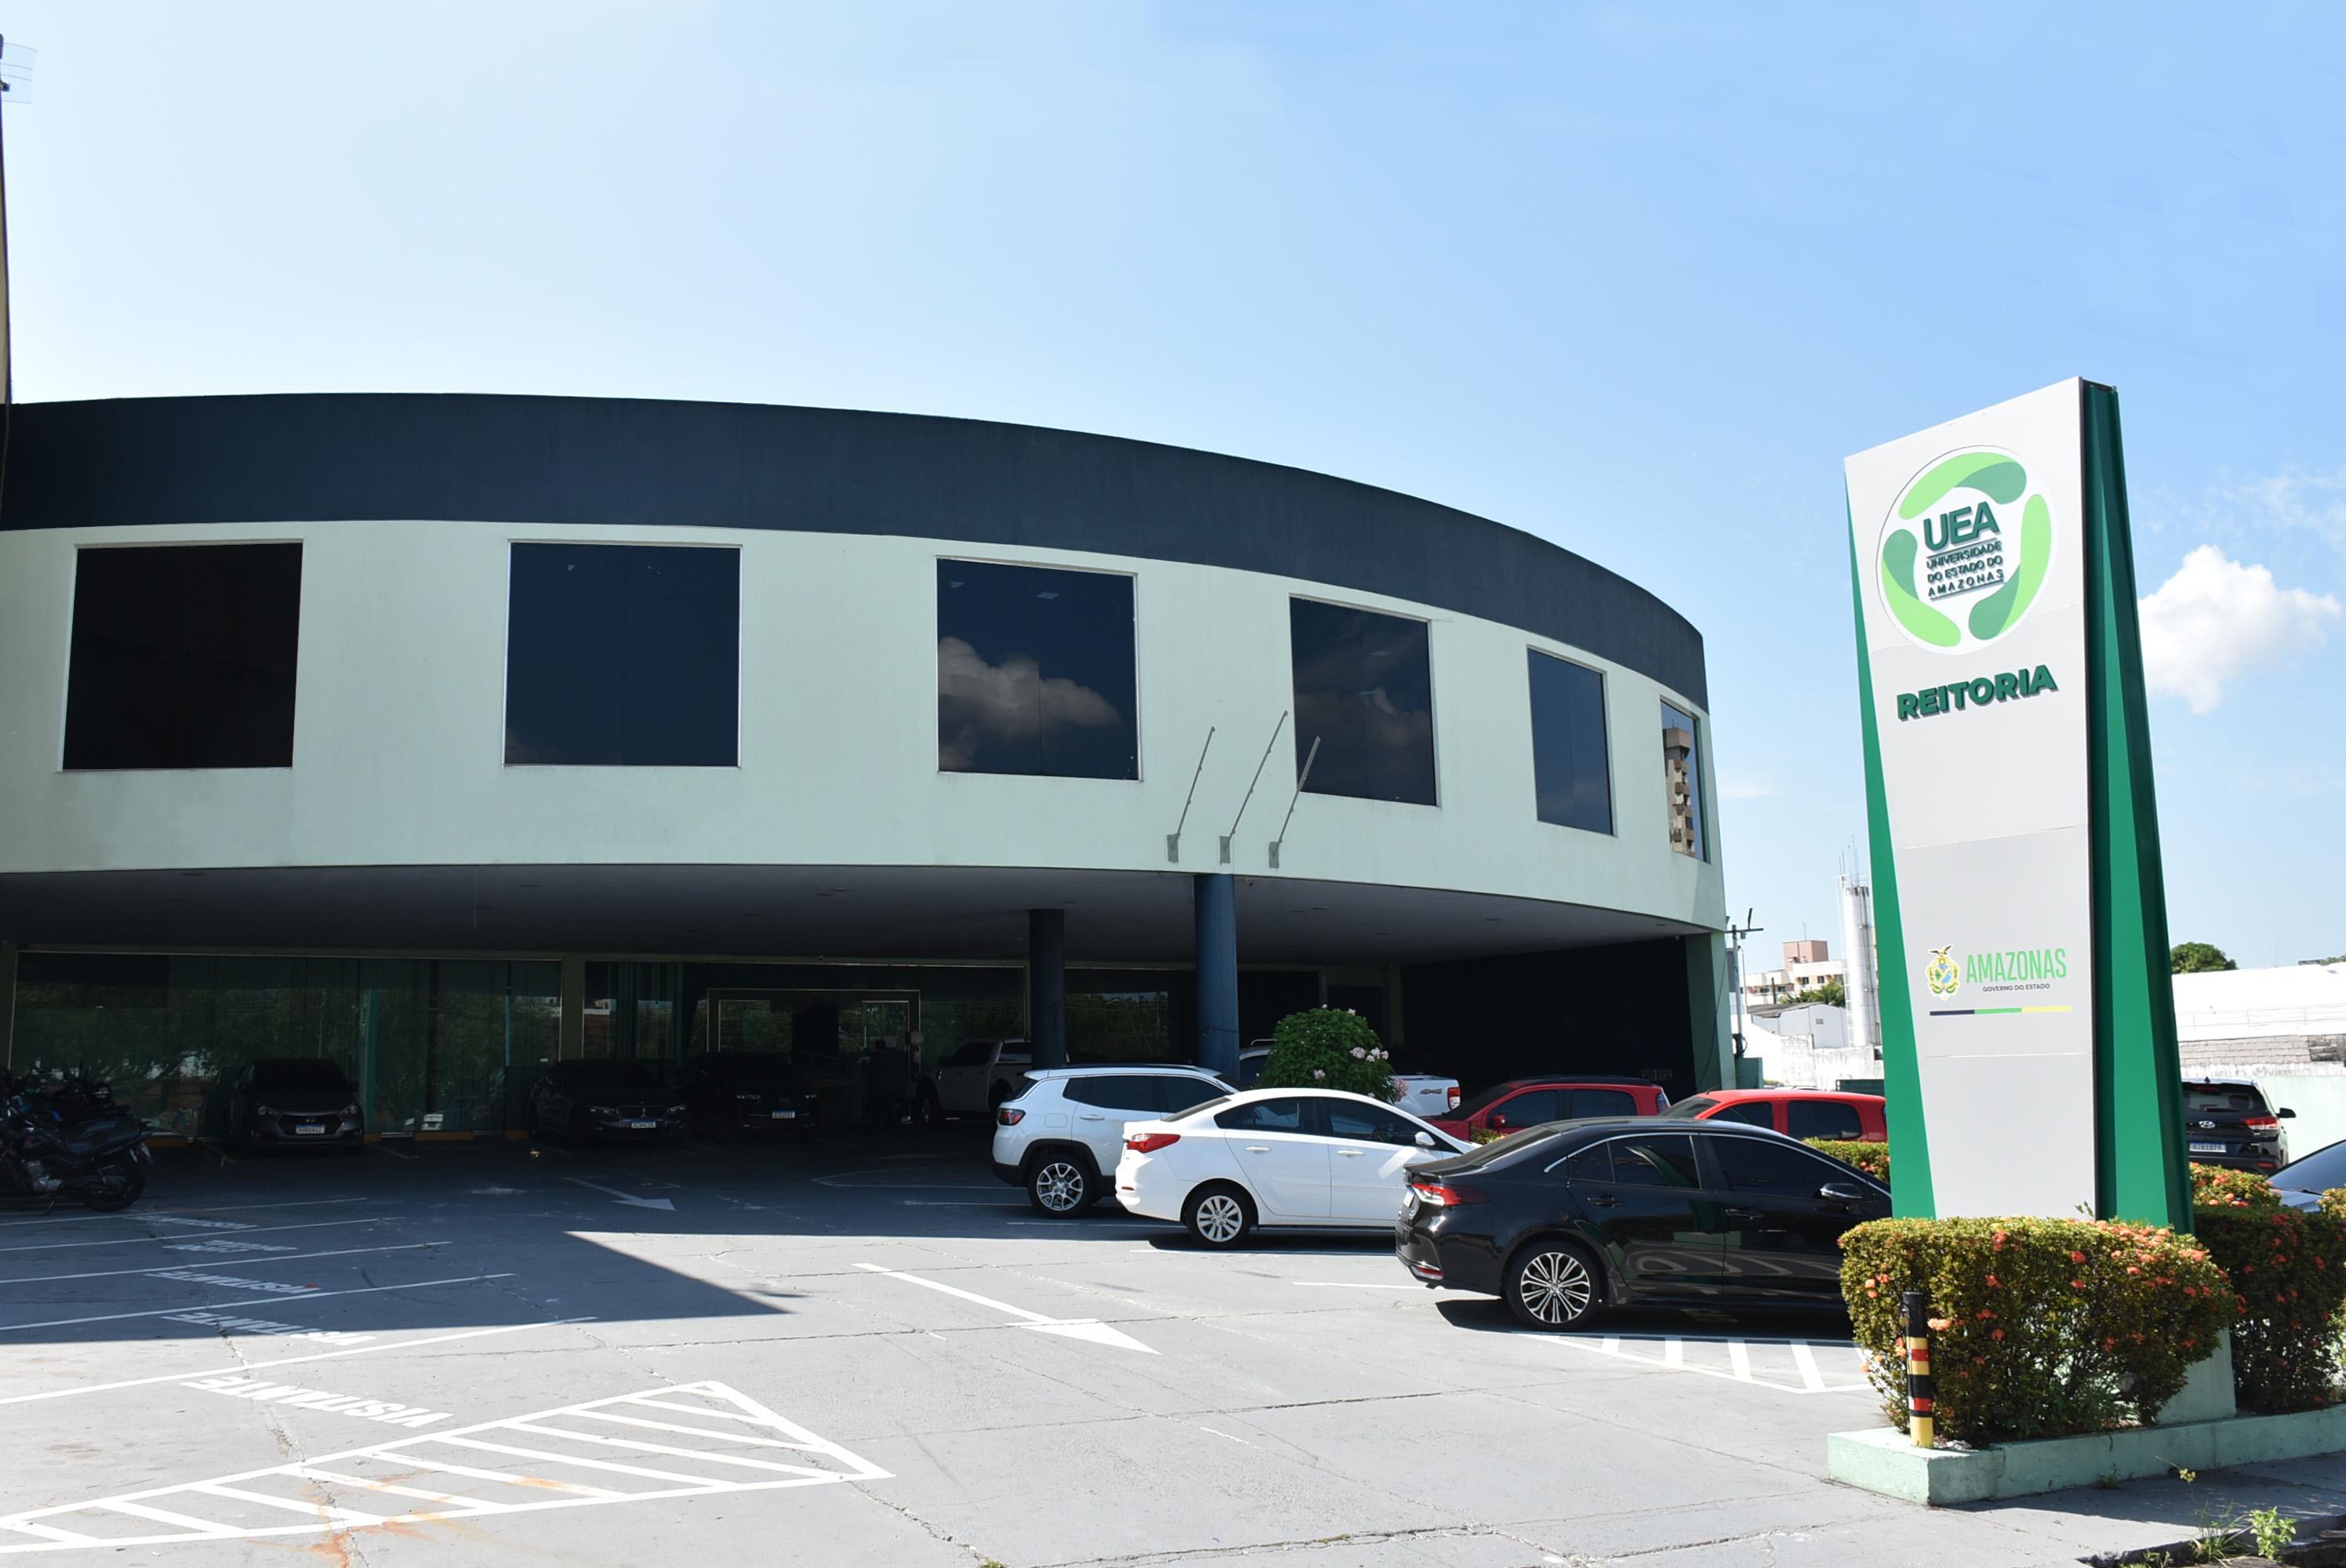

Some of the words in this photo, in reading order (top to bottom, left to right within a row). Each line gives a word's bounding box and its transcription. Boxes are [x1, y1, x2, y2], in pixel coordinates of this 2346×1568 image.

[1923, 502, 2000, 550] UEA
[1926, 541, 2003, 570] UNIVERSIDADE
[1927, 572, 1943, 583] DO
[1945, 559, 1985, 579] ESTADO
[1987, 554, 2003, 568] DO
[1927, 569, 2004, 597] AMAZONAS
[1897, 665, 2059, 720] REITORIA
[1966, 948, 2068, 983] AMAZONAS
[143, 1271, 321, 1294] VISITANTE
[159, 1312, 377, 1346] VISITANTE
[179, 1376, 454, 1428] VISITANTE
